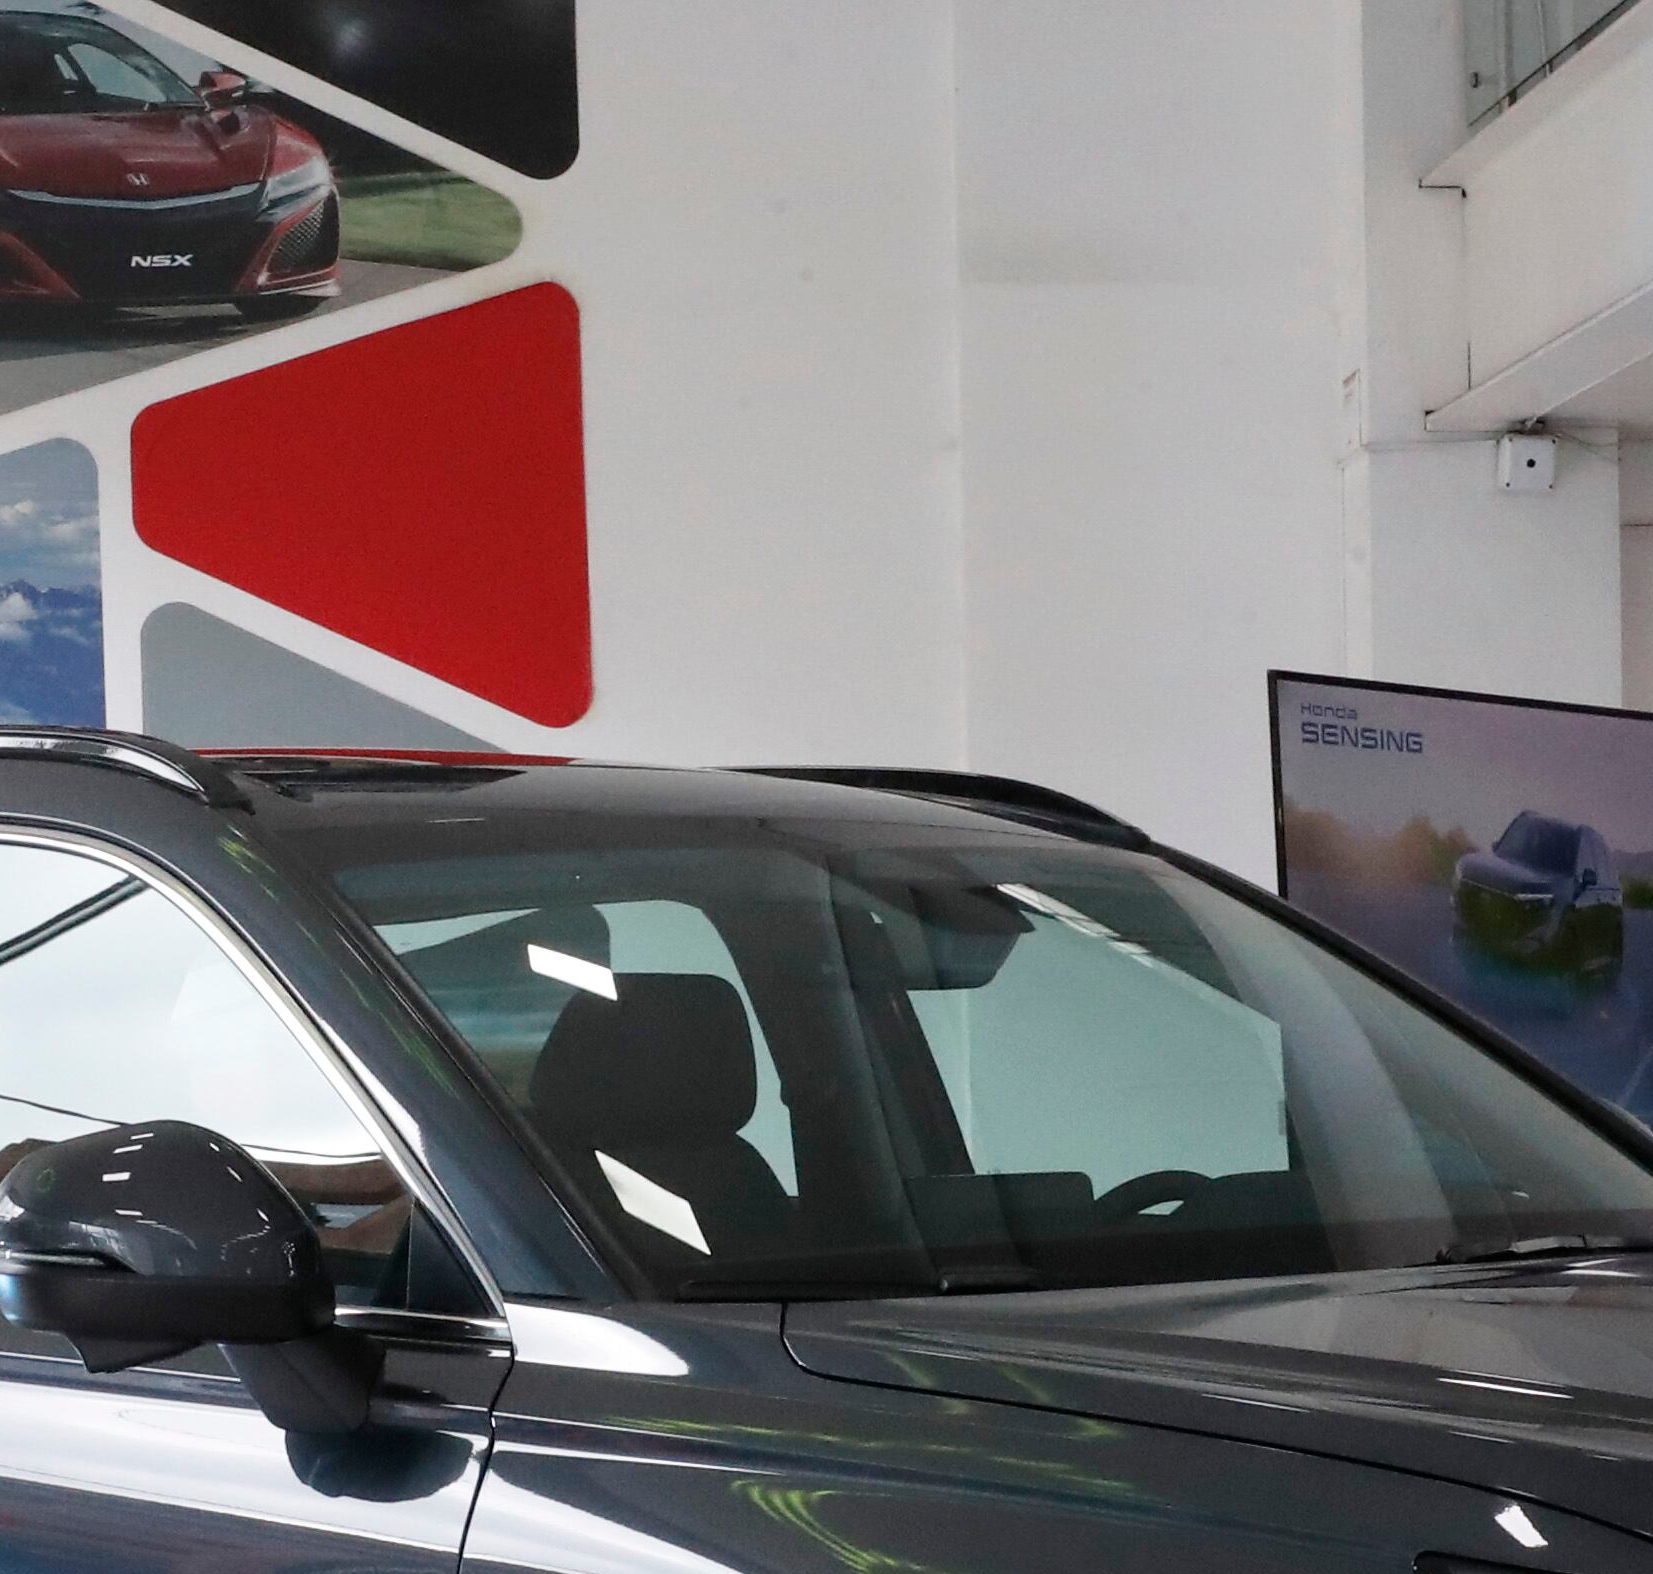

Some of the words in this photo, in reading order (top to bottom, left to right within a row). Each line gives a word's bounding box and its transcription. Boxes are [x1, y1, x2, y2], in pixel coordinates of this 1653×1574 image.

[131, 254, 193, 268] NSX
[1300, 702, 1358, 720] Honda
[1301, 721, 1423, 754] SENSING
